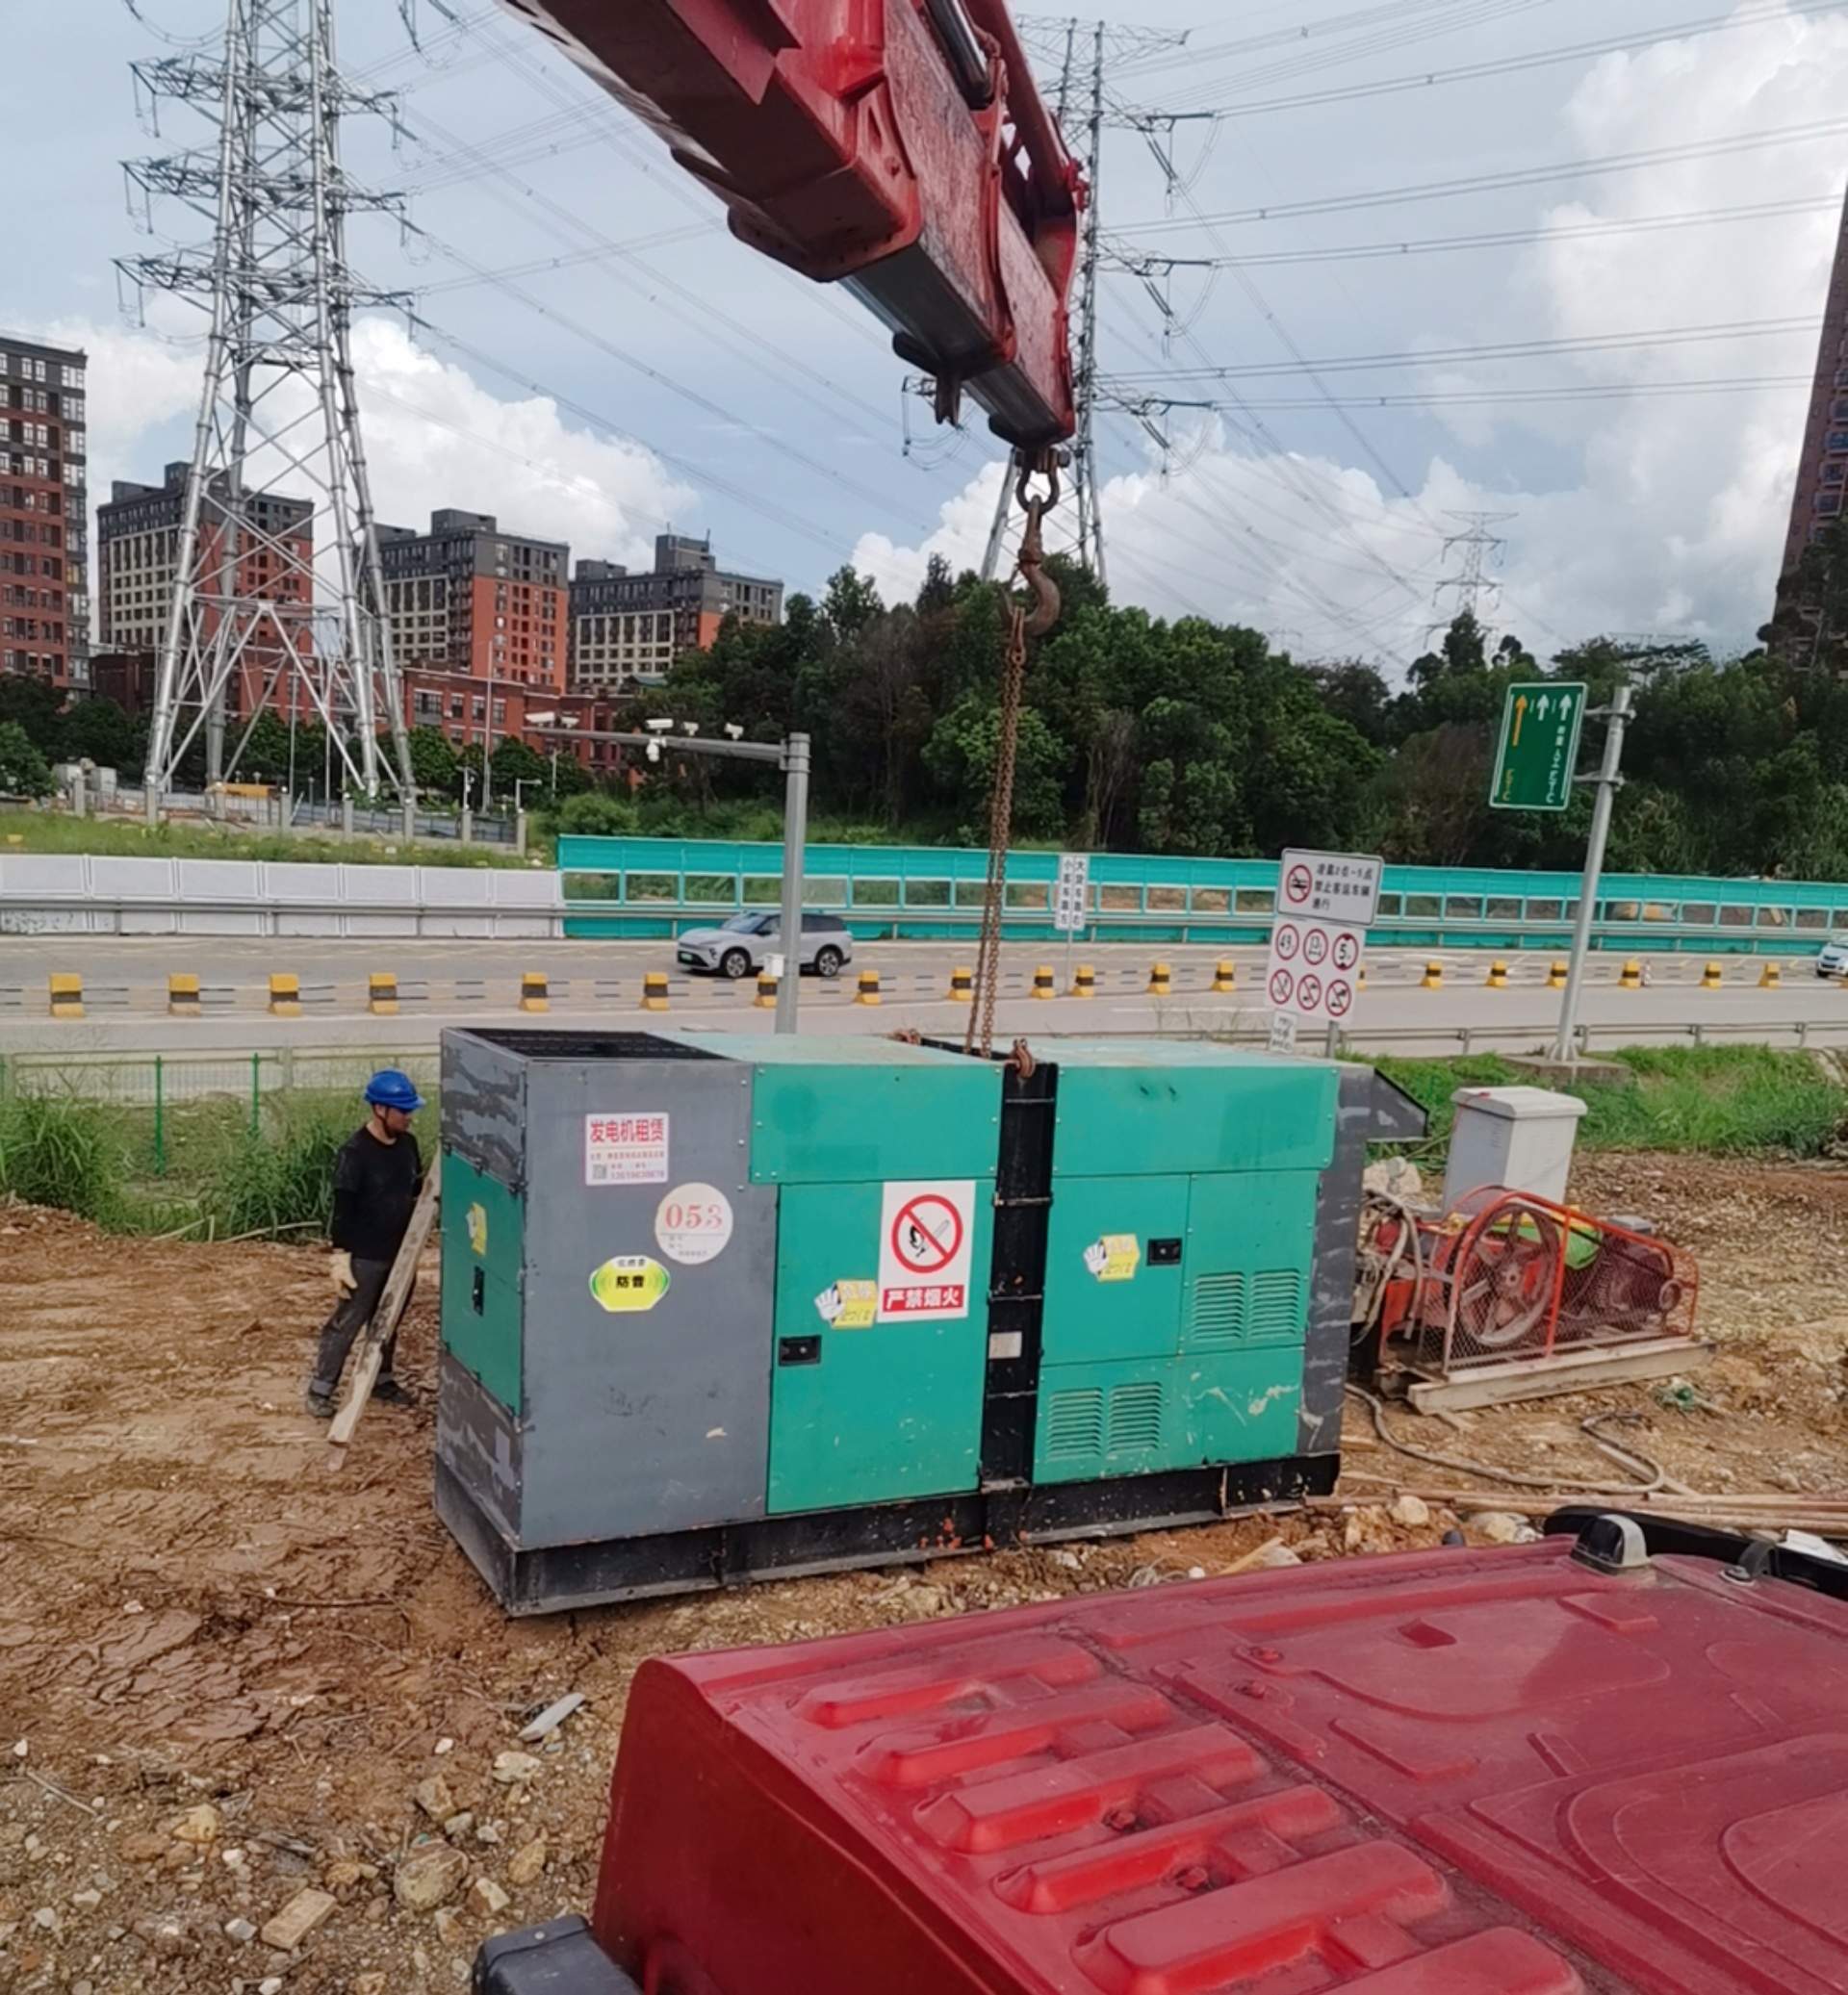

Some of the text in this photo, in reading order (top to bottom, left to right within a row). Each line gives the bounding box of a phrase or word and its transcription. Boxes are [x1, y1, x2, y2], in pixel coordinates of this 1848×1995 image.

[590, 1118, 663, 1143] 发电机租赁
[665, 1203, 723, 1230] 053
[886, 1287, 960, 1310] 严禁烟火
